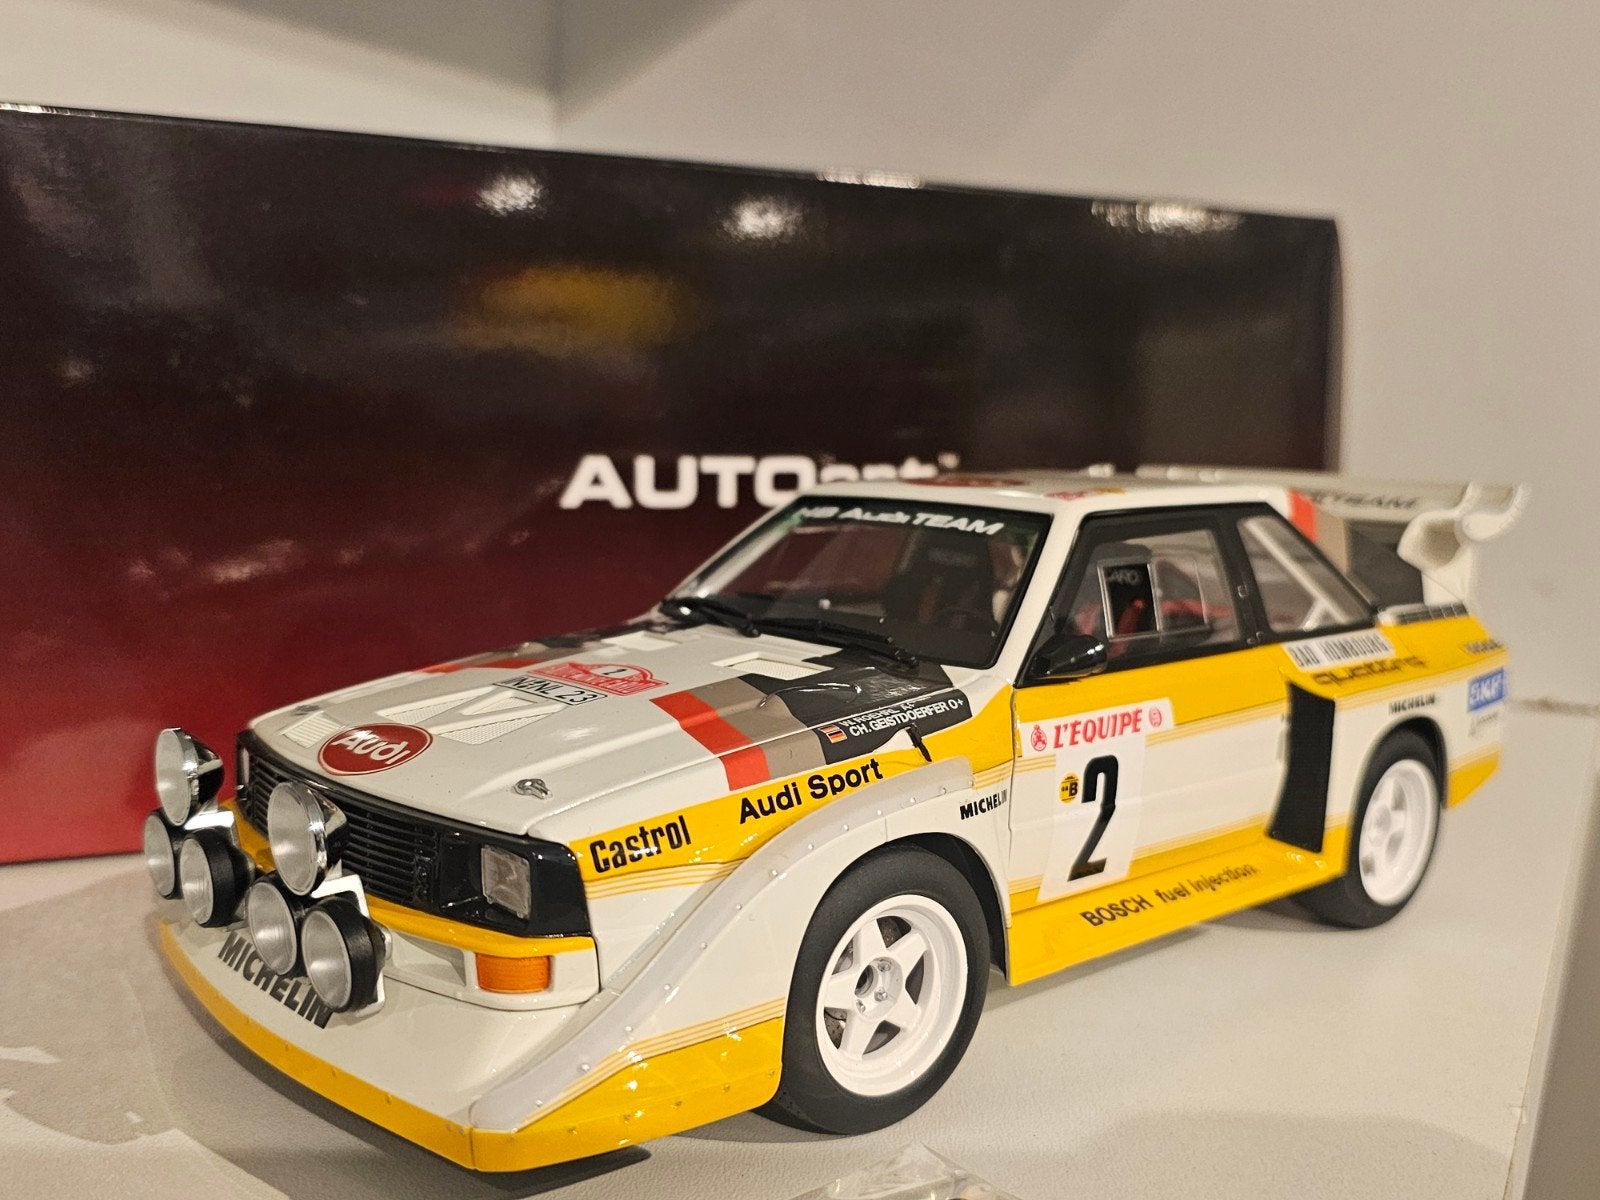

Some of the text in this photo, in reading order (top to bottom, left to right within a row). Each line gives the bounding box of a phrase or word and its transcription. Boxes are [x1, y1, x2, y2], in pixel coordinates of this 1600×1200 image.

[912, 512, 1005, 536] TEAM
[1388, 693, 1436, 715] MICHELIN
[331, 729, 411, 765] Audi
[739, 757, 884, 825] Audi Sport
[1067, 754, 1119, 882] 2
[589, 814, 692, 874] Castrol
[1080, 894, 1154, 927] BOSCH
[1154, 881, 1191, 904] fuel
